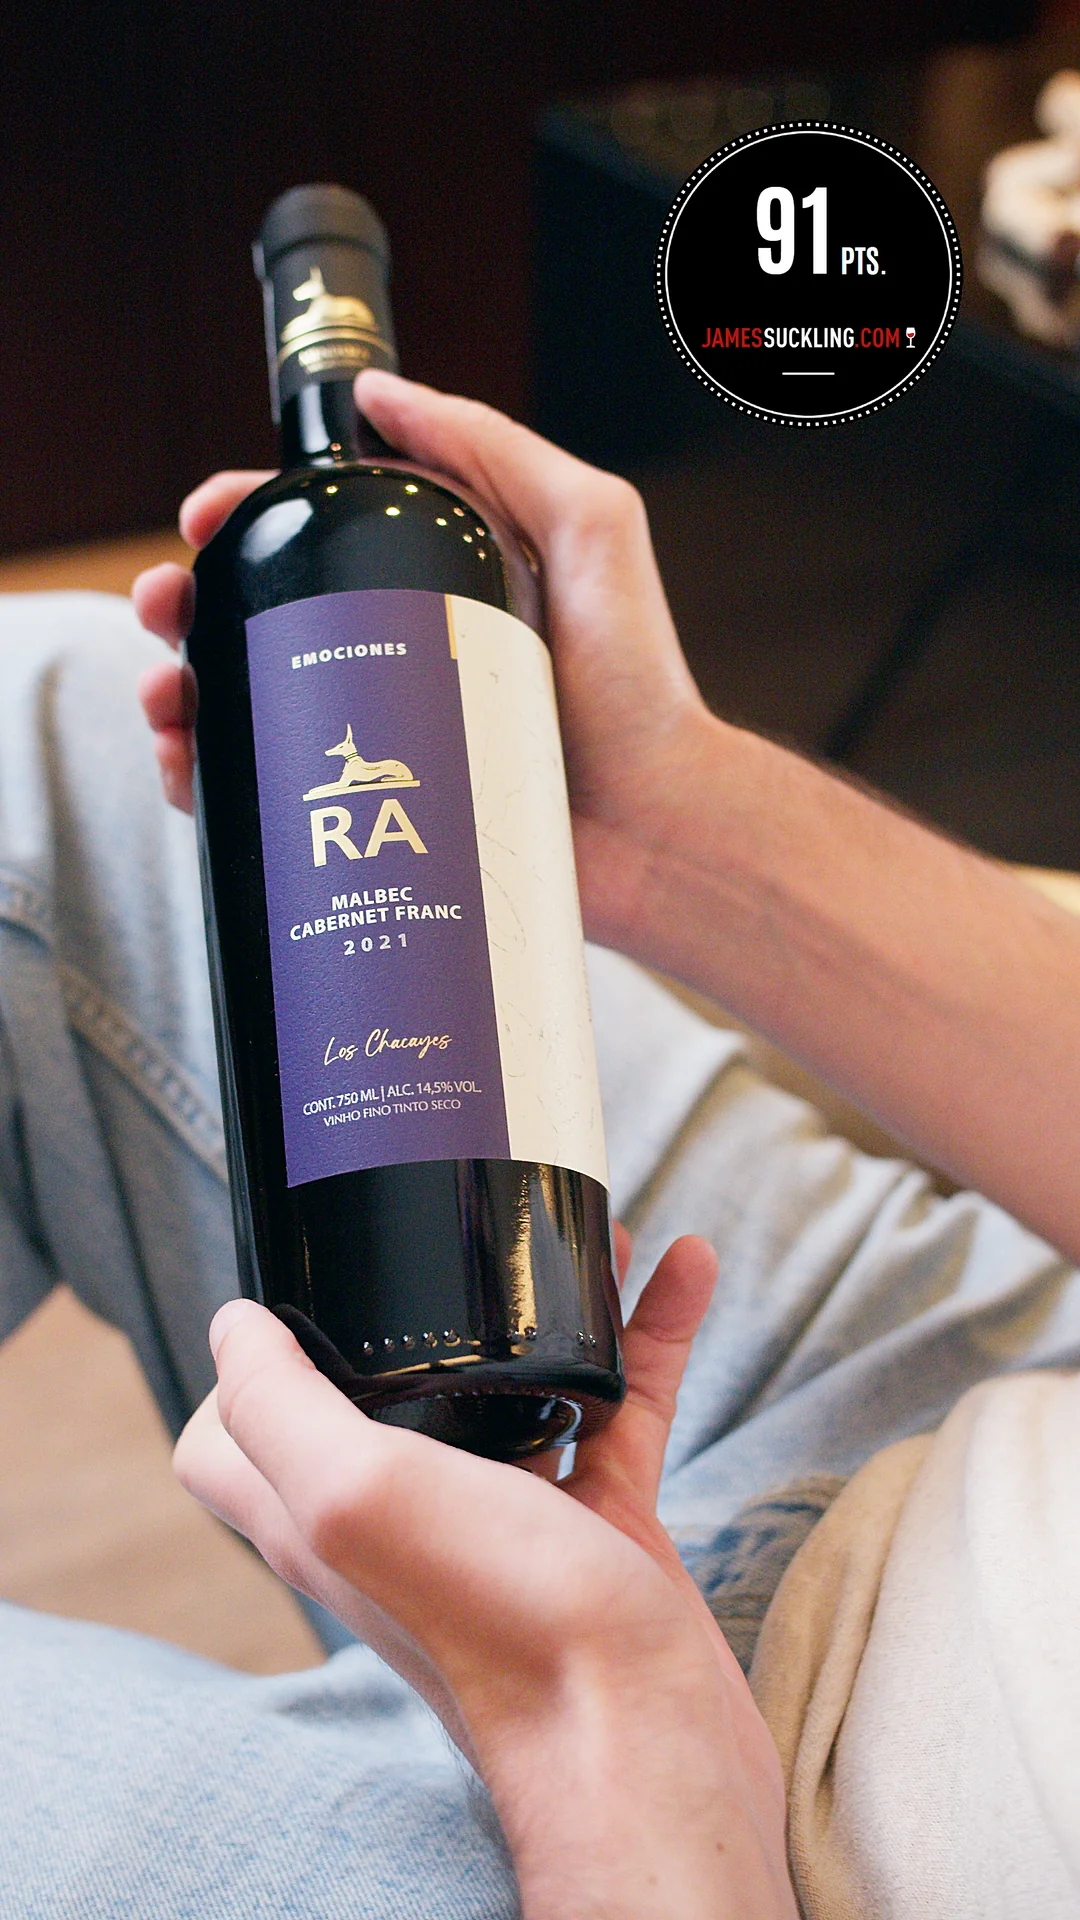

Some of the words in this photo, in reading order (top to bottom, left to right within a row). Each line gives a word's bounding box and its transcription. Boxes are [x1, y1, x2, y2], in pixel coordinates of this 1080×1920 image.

[291, 642, 407, 670] EMOCIONES
[309, 798, 429, 867] RA
[331, 886, 413, 911] MALBEC
[289, 907, 390, 941] CABERNET
[395, 904, 463, 921] FRANC
[343, 933, 408, 956] 2021
[323, 1036, 358, 1066] Los
[364, 1028, 453, 1059] Chacayes
[302, 1097, 336, 1116] CONT.
[336, 1091, 359, 1108] 750
[360, 1088, 379, 1102] ML
[386, 1083, 415, 1098] ALC.
[416, 1081, 454, 1095] 14,5%
[454, 1080, 483, 1093] VOL.
[323, 1111, 361, 1127] VINHO
[363, 1104, 392, 1118] FINO
[392, 1100, 429, 1113] TINTO
[431, 1098, 462, 1111] SECO
